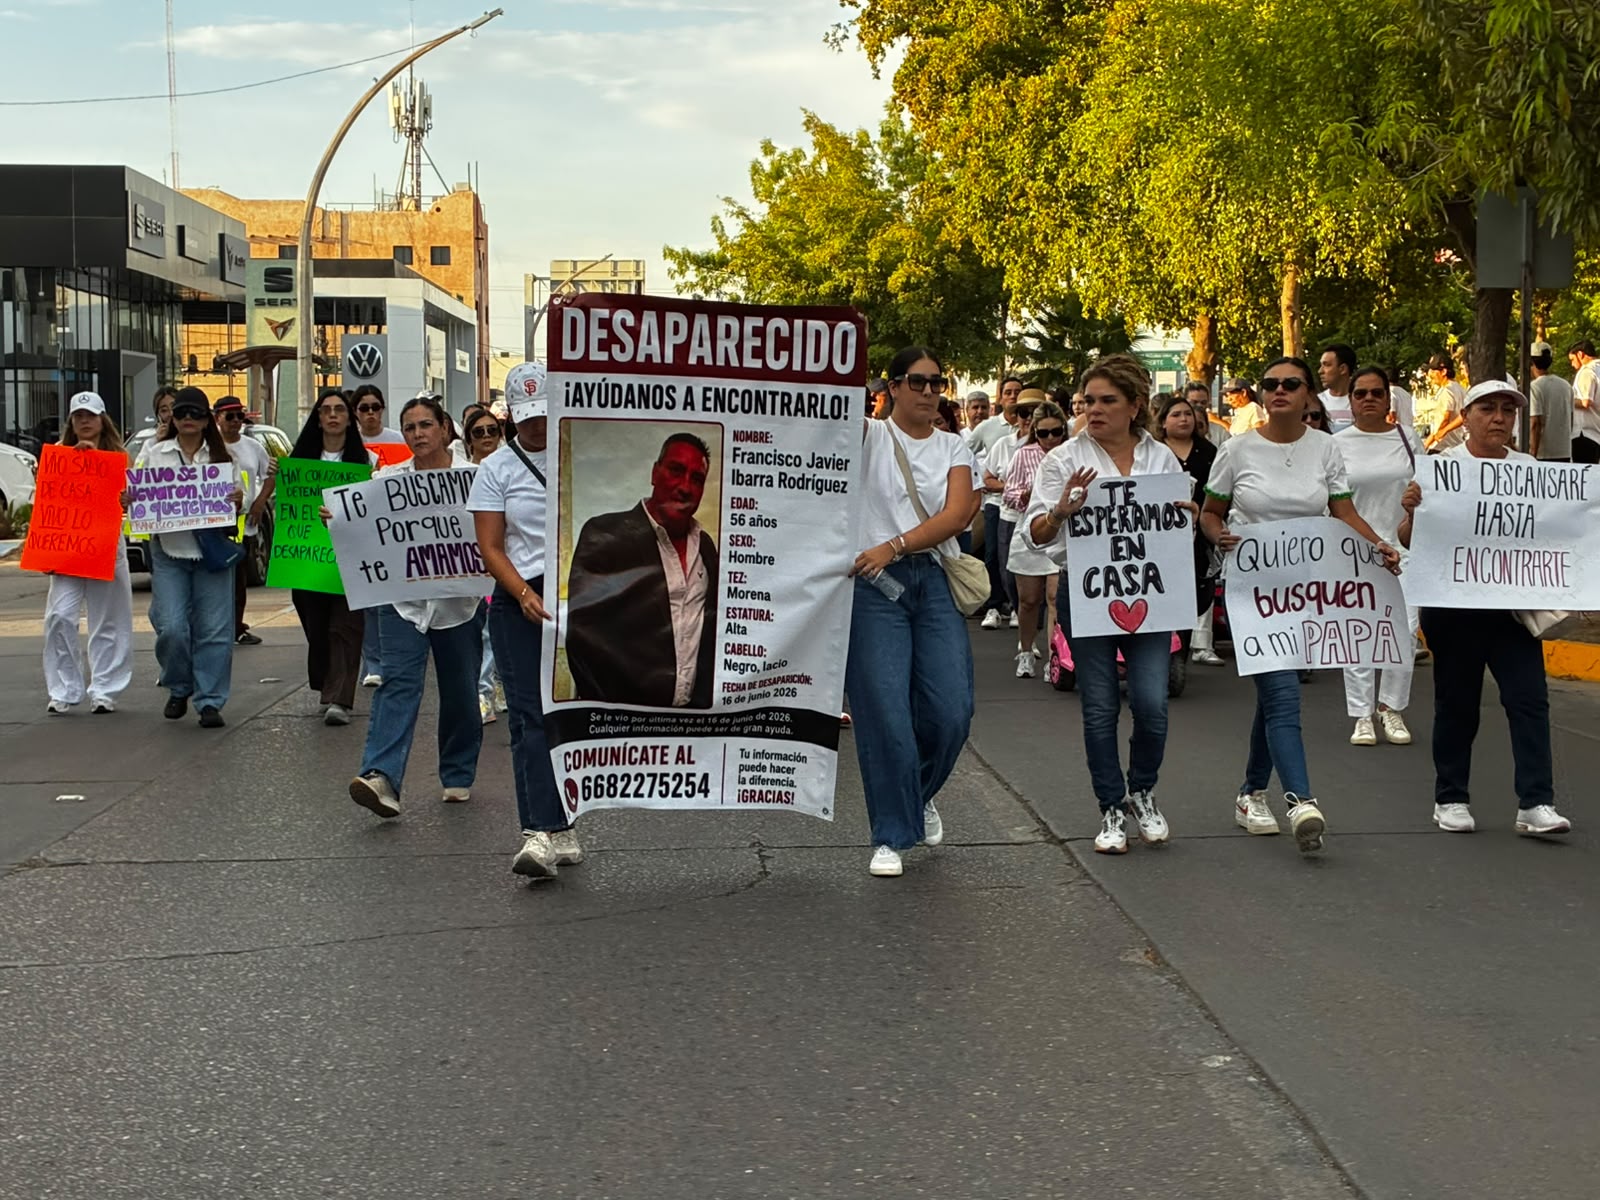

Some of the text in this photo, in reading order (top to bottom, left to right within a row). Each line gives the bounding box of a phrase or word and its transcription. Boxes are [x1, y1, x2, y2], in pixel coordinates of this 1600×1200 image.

[561, 307, 858, 375] DESAPARECIDO
[564, 377, 849, 420] ¡AYÚDANOS A ENCONTRARLO!
[732, 430, 773, 444] NOMBRE:
[732, 447, 850, 472] Francisco Javier
[280, 466, 302, 486] HAY
[731, 469, 848, 495] Ibarra Rodríguez
[1434, 459, 1593, 501] NO DESCANSARÉ
[40, 481, 92, 500] DE CASA
[333, 470, 477, 522] Te BUSCAMO
[1099, 480, 1137, 507] TE
[280, 503, 317, 521] EN EL
[730, 497, 758, 510] EDAD:
[71, 508, 92, 530] LO
[730, 513, 778, 528] 56 años
[1068, 503, 1188, 537] ESPERAMOS
[1474, 501, 1535, 539] HASTA
[287, 524, 312, 540] QUE
[728, 534, 756, 547] SEXO:
[28, 531, 97, 557] QUEREMOS
[274, 544, 336, 564] DESAPAREC
[1110, 533, 1146, 562] EN
[1236, 530, 1385, 577] Quiero que
[359, 542, 489, 584] te AMAMOS
[728, 550, 775, 566] Hombre
[1453, 546, 1572, 588] ENCONTRARTE
[727, 571, 747, 584] TEZ:
[1083, 562, 1165, 599] CASA
[727, 586, 771, 601] Morena
[1253, 580, 1376, 619] busquen
[725, 607, 774, 622] ESTATURA:
[725, 622, 747, 635] Alta
[1243, 604, 1403, 665] a mi PAPÁ
[724, 642, 767, 657] CABELLO:
[723, 659, 788, 675] Negro, lacio
[722, 673, 813, 693] FECHA DE DESAPARICIÓN:
[722, 687, 798, 706] 16 de junio 2026
[590, 712, 602, 722] Se
[603, 713, 612, 721] le
[615, 713, 629, 722] vio
[631, 716, 647, 724] por
[648, 715, 676, 723] última
[679, 716, 694, 724] vez
[708, 716, 718, 724] 16
[732, 715, 754, 725] junio
[755, 712, 766, 721] de
[768, 712, 793, 723] 2026.
[589, 724, 630, 735] Cualquier
[632, 724, 684, 733] información
[686, 725, 712, 734] puede
[730, 725, 741, 733] de
[743, 725, 763, 734] gran
[764, 725, 794, 735] ayuda.
[564, 742, 696, 773] COMUNÍCATE AL
[739, 748, 808, 764] Tu información
[739, 762, 796, 775] puede hacer
[581, 772, 710, 801] 6682275254
[737, 774, 797, 788] la diferencia.
[737, 789, 795, 805] ¡GRACIAS!
